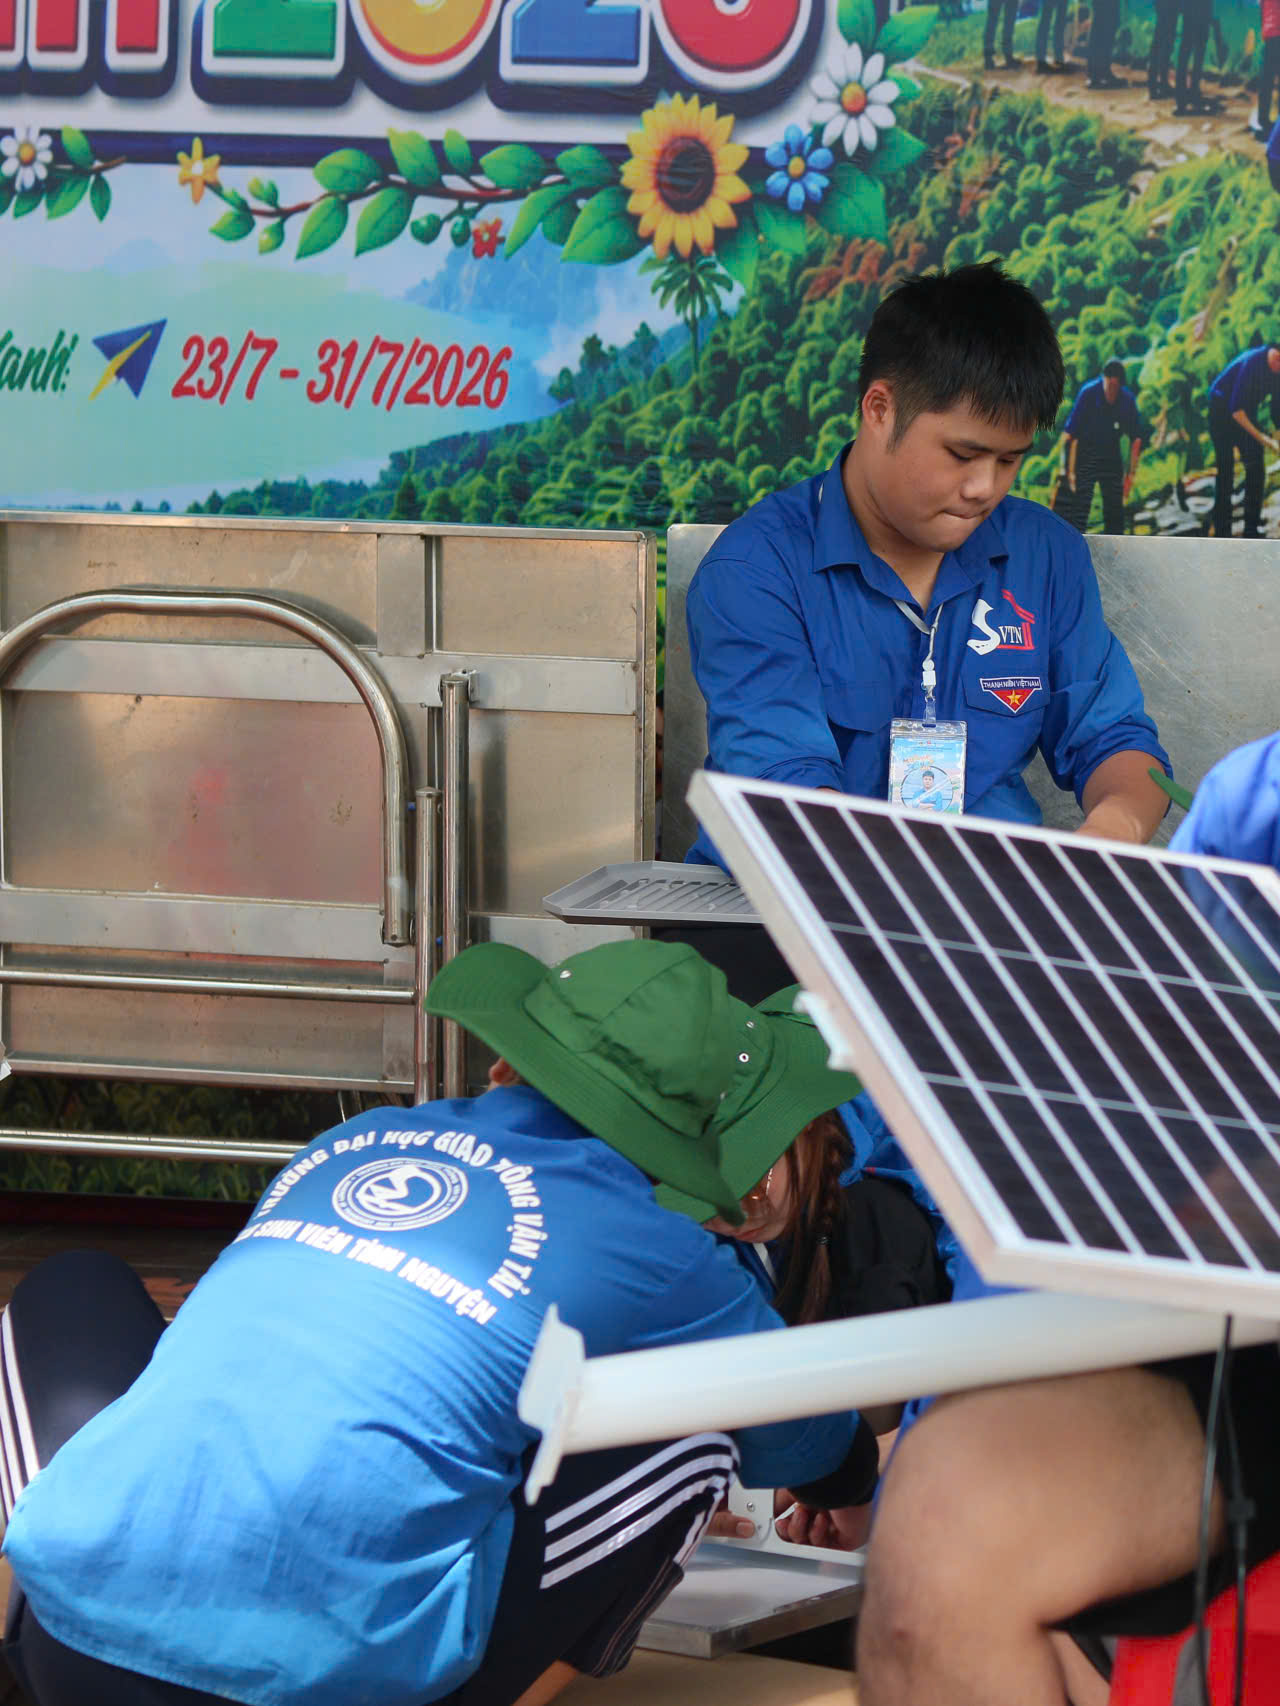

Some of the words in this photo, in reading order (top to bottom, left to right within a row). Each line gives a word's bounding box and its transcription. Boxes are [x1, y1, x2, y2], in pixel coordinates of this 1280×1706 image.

[171, 330, 279, 405] 23/7
[306, 335, 513, 412] 31/7/2026
[433, 1131, 494, 1168] GIAO
[485, 1158, 541, 1208] ÔNG
[295, 1222, 354, 1255] VIÊN
[398, 1257, 498, 1326] NGUYỆN
[488, 1258, 533, 1298] TẢI
